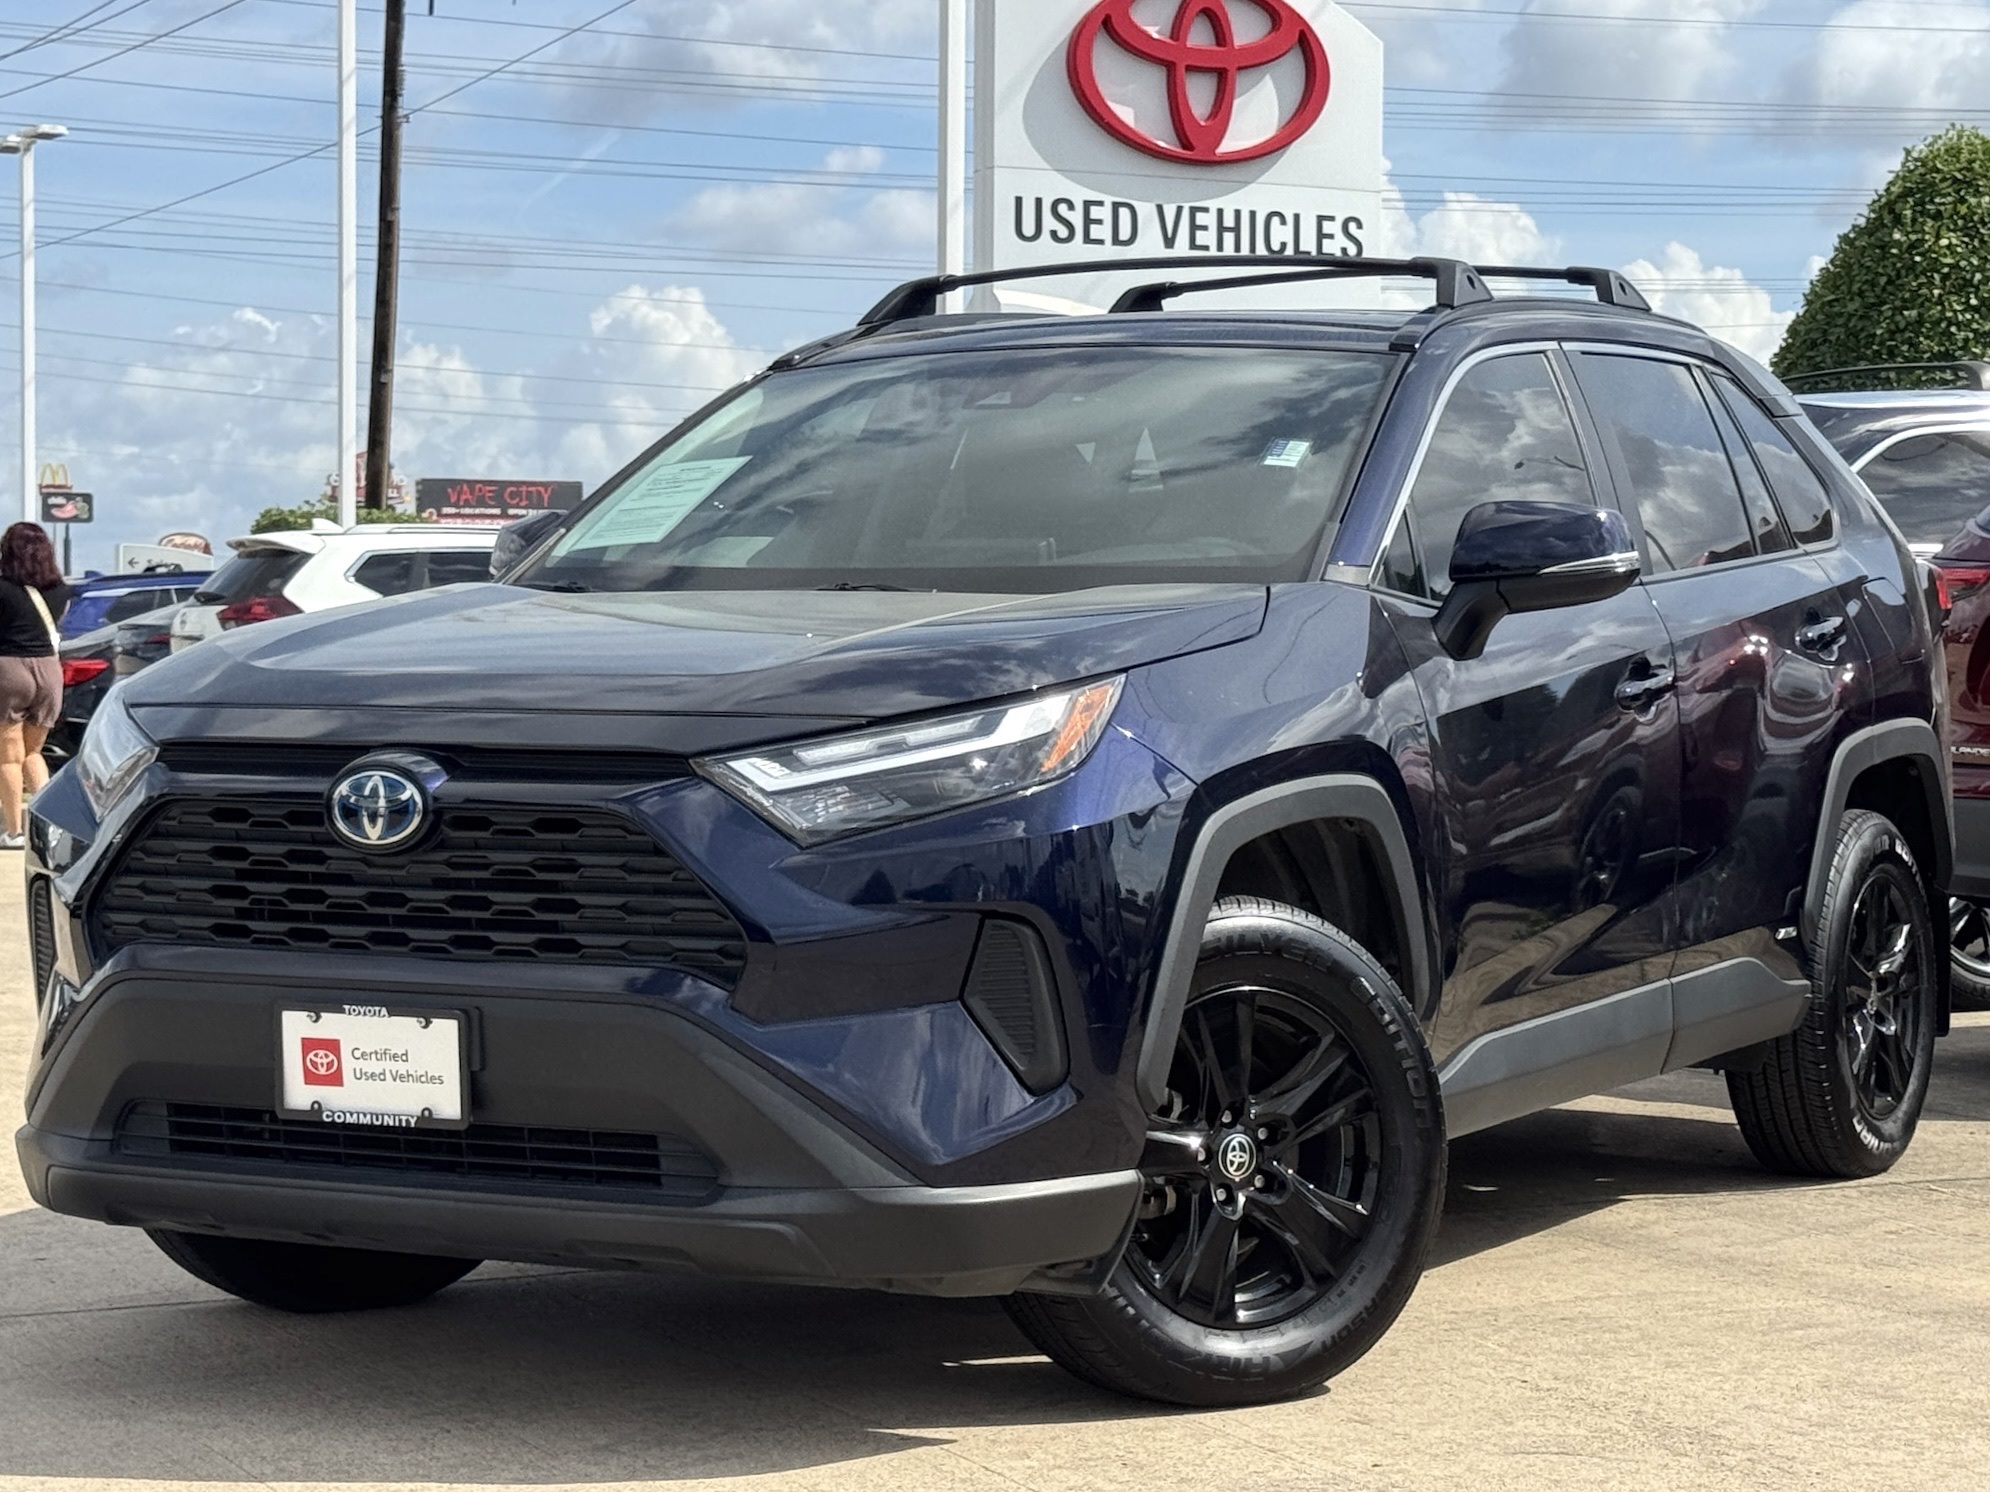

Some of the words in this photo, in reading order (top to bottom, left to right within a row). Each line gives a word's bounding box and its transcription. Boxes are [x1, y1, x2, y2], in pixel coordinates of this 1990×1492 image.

[1014, 195, 1138, 246] USED
[1156, 203, 1364, 258] VEHICLES
[448, 484, 499, 505] VAPE
[504, 485, 554, 507] CITY
[343, 1005, 389, 1017] TOYOTA
[351, 1047, 409, 1063] Certified
[353, 1068, 386, 1082] Used
[389, 1069, 444, 1085] Vehicles
[322, 1110, 418, 1127] COMMUNITY
